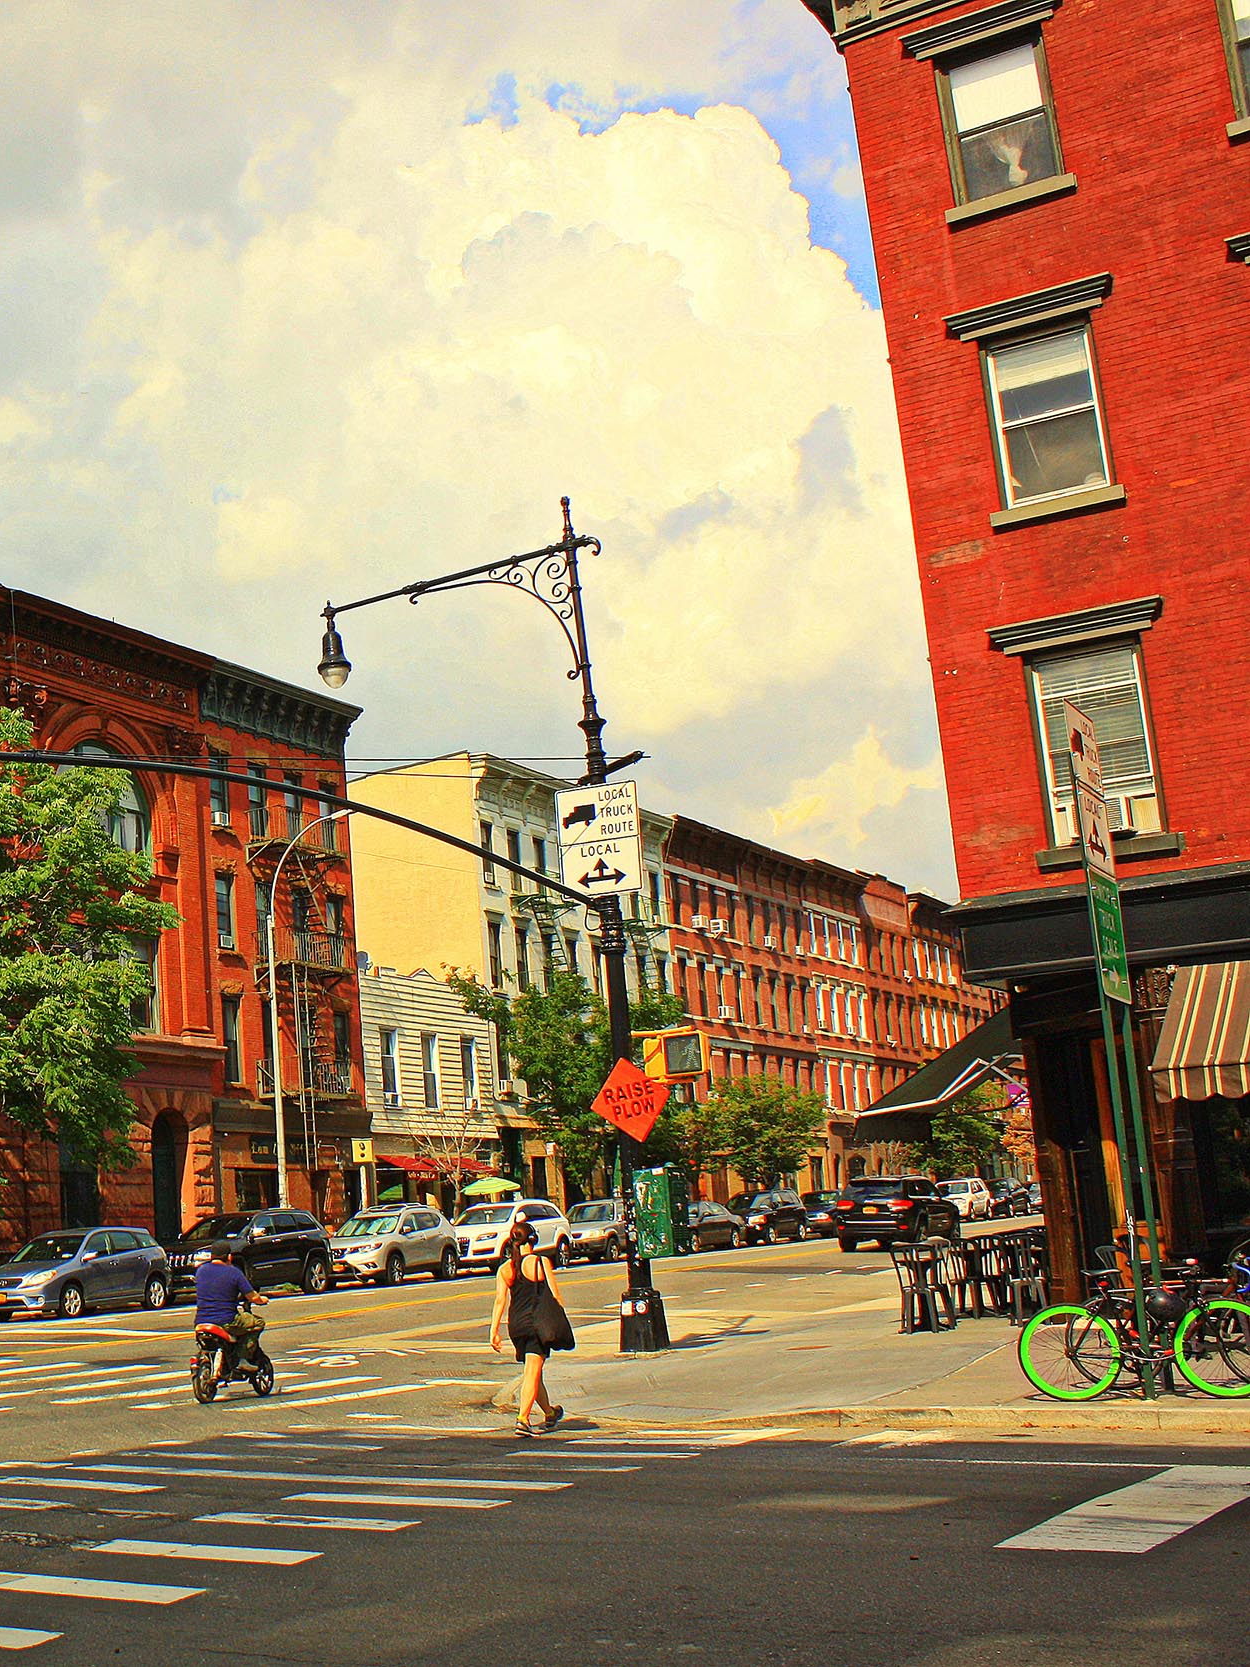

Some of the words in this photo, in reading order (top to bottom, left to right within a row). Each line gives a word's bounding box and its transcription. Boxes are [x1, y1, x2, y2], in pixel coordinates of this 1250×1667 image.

[598, 787, 632, 802] LOCAL
[600, 803, 634, 818] TRUCK
[601, 820, 634, 836] ROUTE
[581, 842, 621, 858] LOCAL
[602, 1080, 655, 1105] RAISE
[611, 1097, 656, 1121] PLOW
